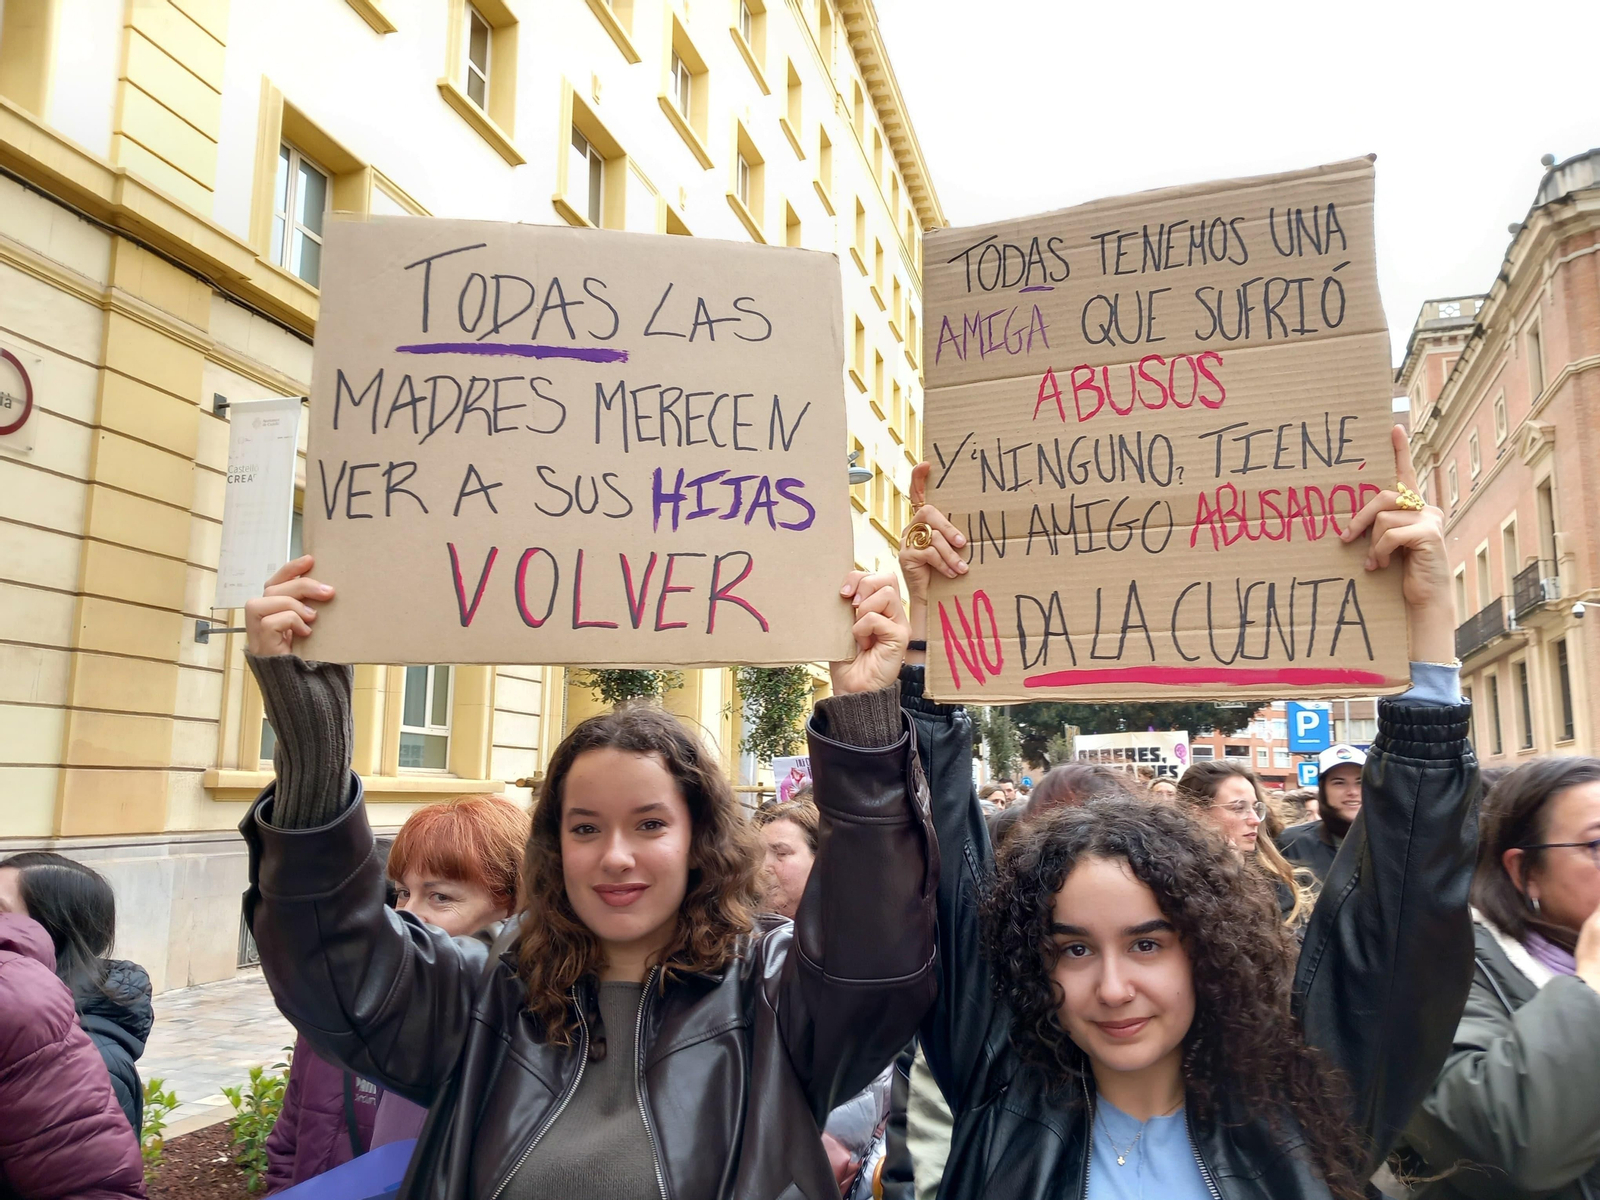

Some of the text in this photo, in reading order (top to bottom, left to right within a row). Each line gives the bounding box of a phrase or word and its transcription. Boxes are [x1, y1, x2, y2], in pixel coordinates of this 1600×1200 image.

[947, 203, 1346, 293] TODAS TENEMOS UNA
[404, 243, 772, 342] TODAS LAS
[936, 261, 1352, 366] AMIGA QUE SUFRIÓ
[333, 368, 811, 453] MADRES MERECEN
[1030, 351, 1225, 422] ABUSOS
[318, 460, 815, 533] VER A SUS HIJAS
[1024, 494, 1176, 555] AMIGO
[447, 542, 769, 634] VOLVER
[937, 576, 1375, 690] NO DA LA CUENTA
[1296, 711, 1320, 737] P
[1302, 765, 1318, 784] P
